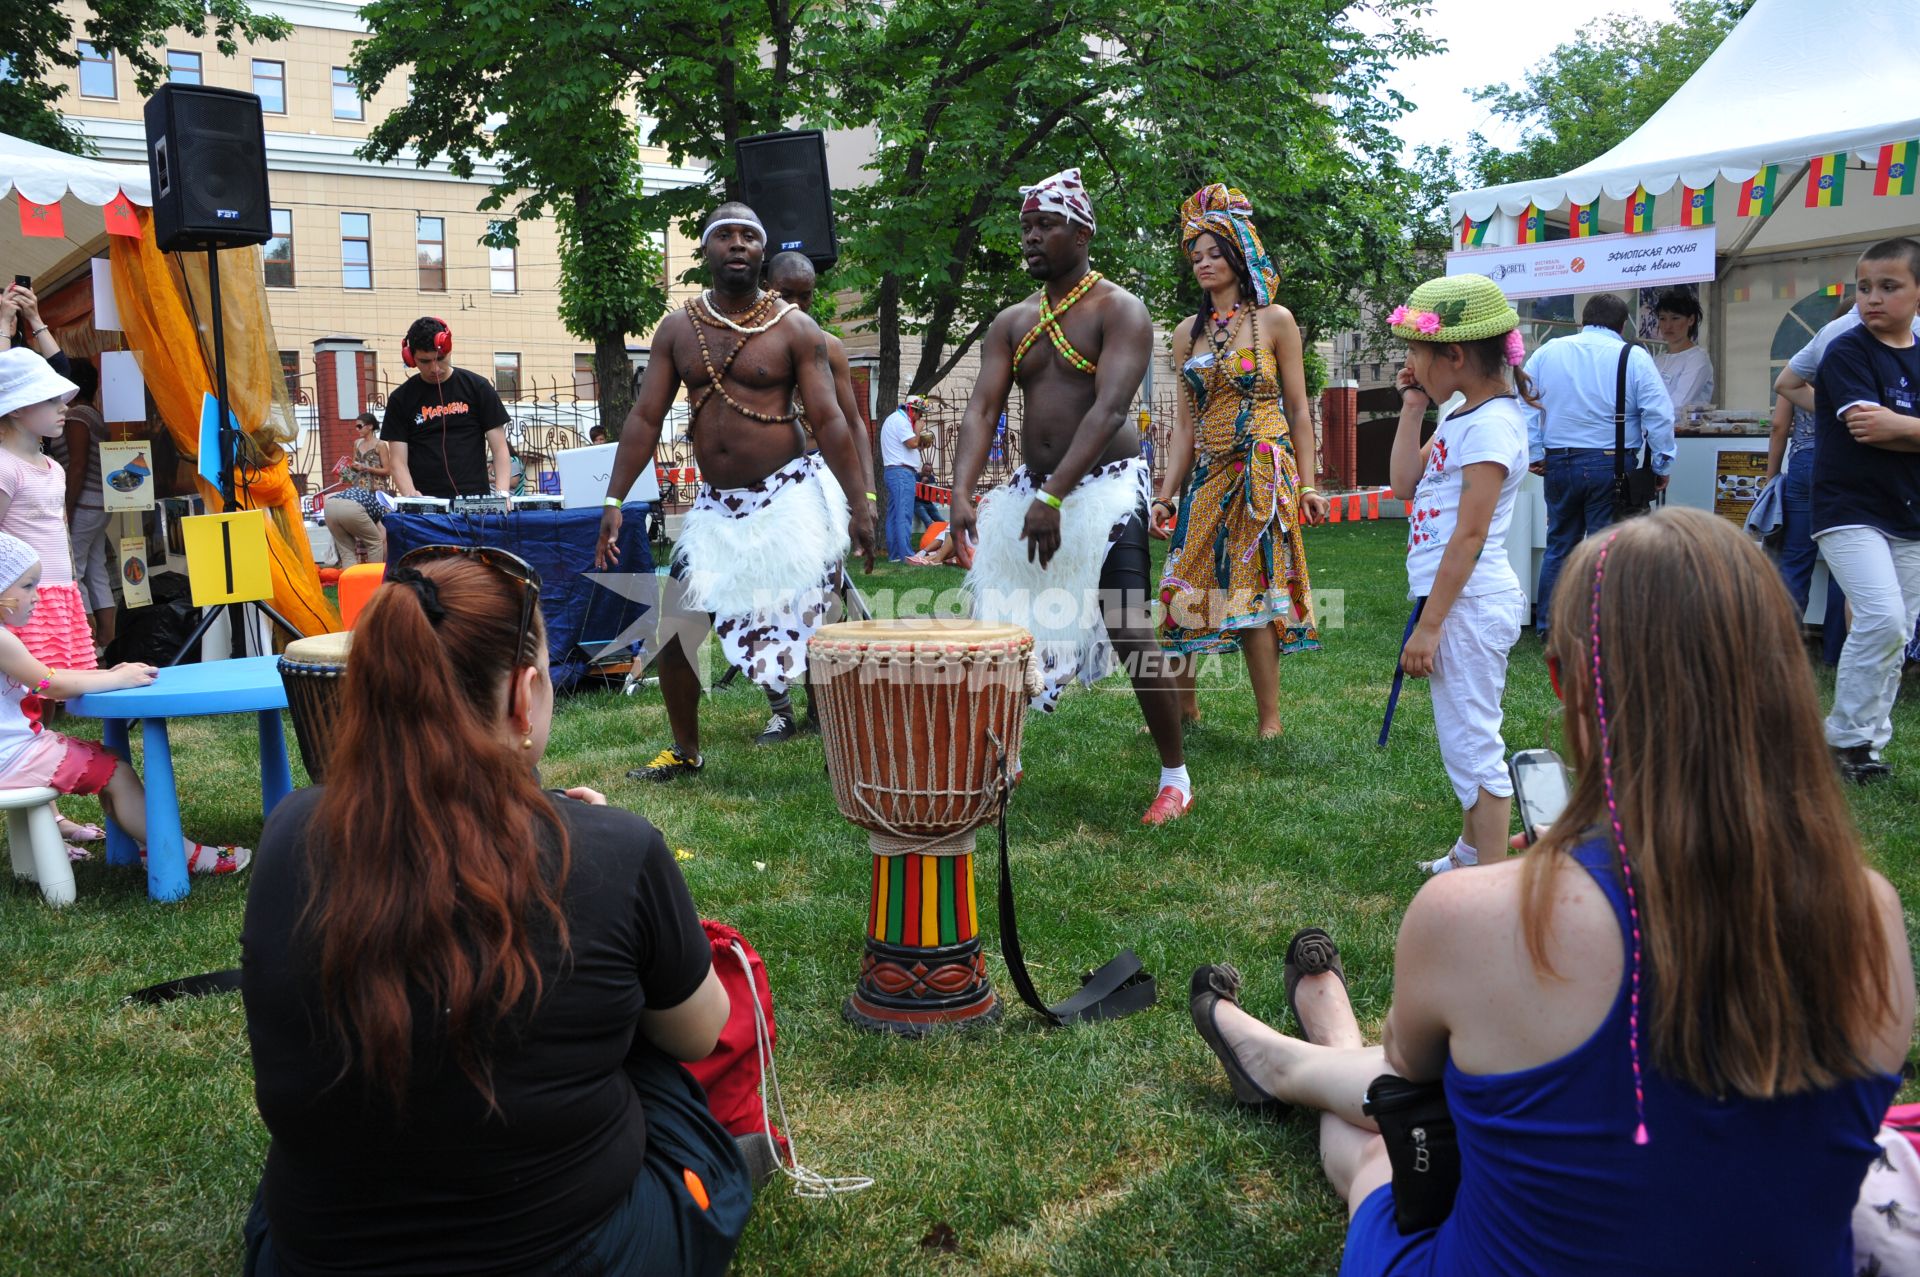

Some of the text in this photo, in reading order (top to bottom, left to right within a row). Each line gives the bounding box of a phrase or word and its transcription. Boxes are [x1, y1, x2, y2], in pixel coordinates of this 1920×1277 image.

[1607, 242, 1698, 262] ЭФИОПСКАЯ КУХНЯ
[1621, 259, 1681, 277] кафе Авеню
